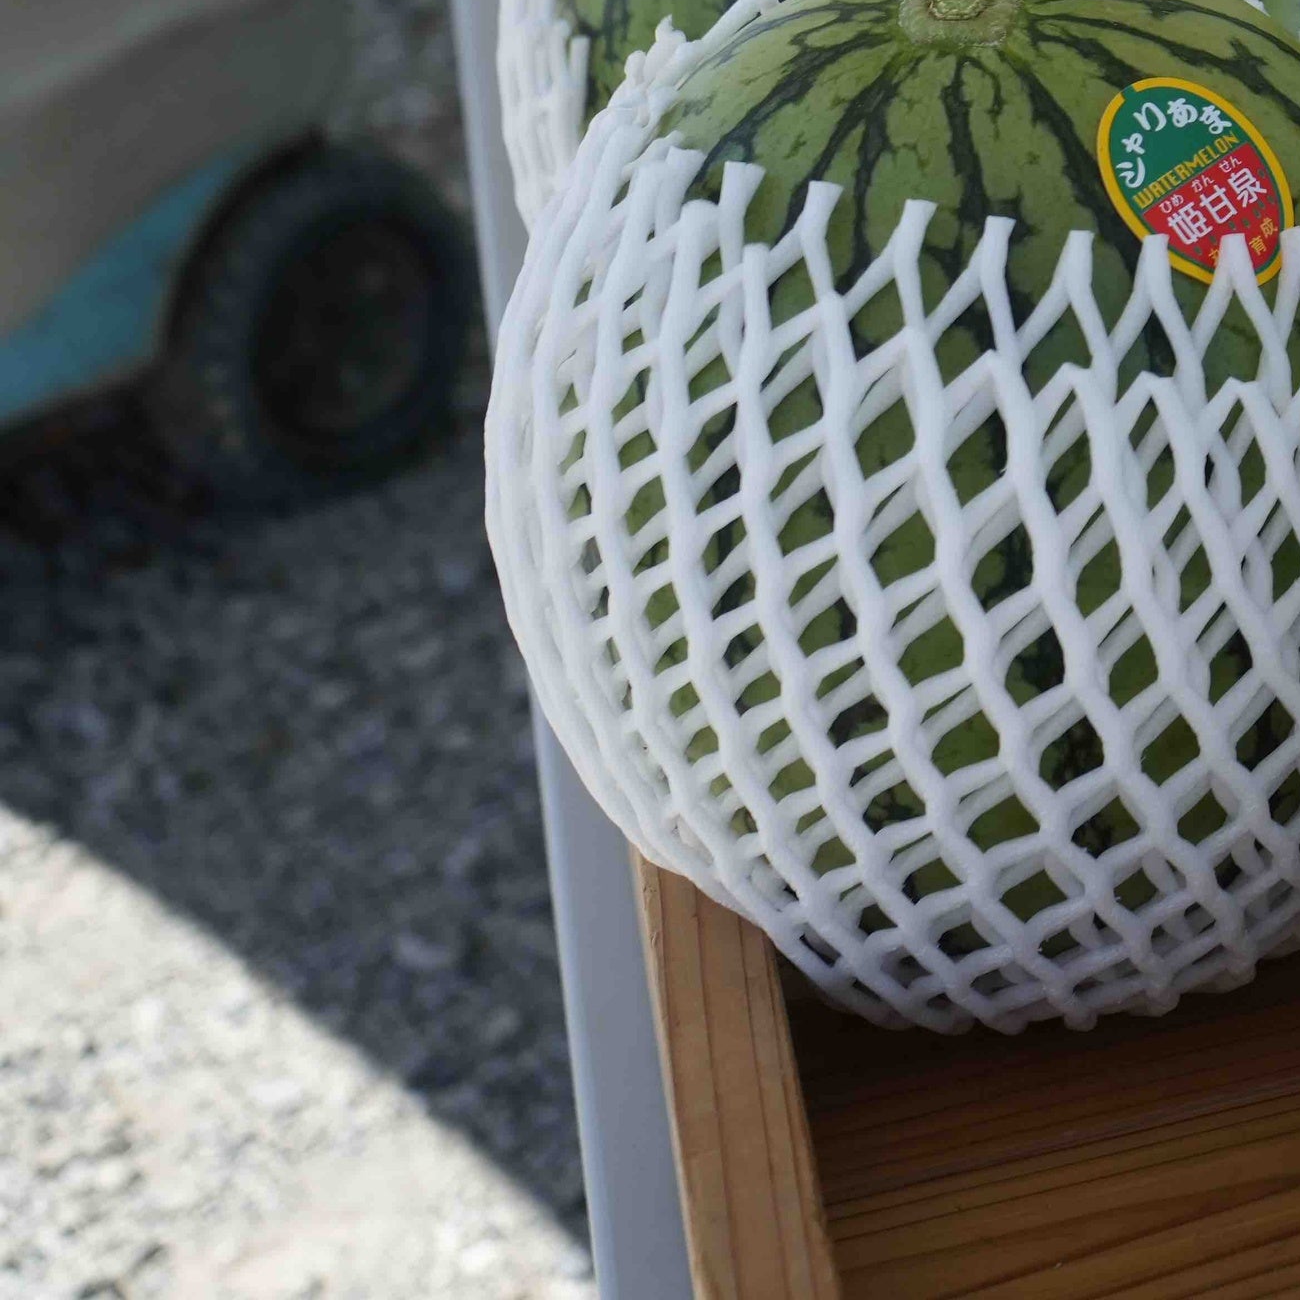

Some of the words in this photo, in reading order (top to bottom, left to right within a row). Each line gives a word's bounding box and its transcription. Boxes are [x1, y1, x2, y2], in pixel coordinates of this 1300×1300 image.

[1132, 130, 1240, 210] WATERMELON
[1159, 193, 1184, 214] ひめ
[1191, 173, 1216, 194] かん
[1218, 155, 1243, 174] せん
[1167, 167, 1268, 246] 姫甘泉
